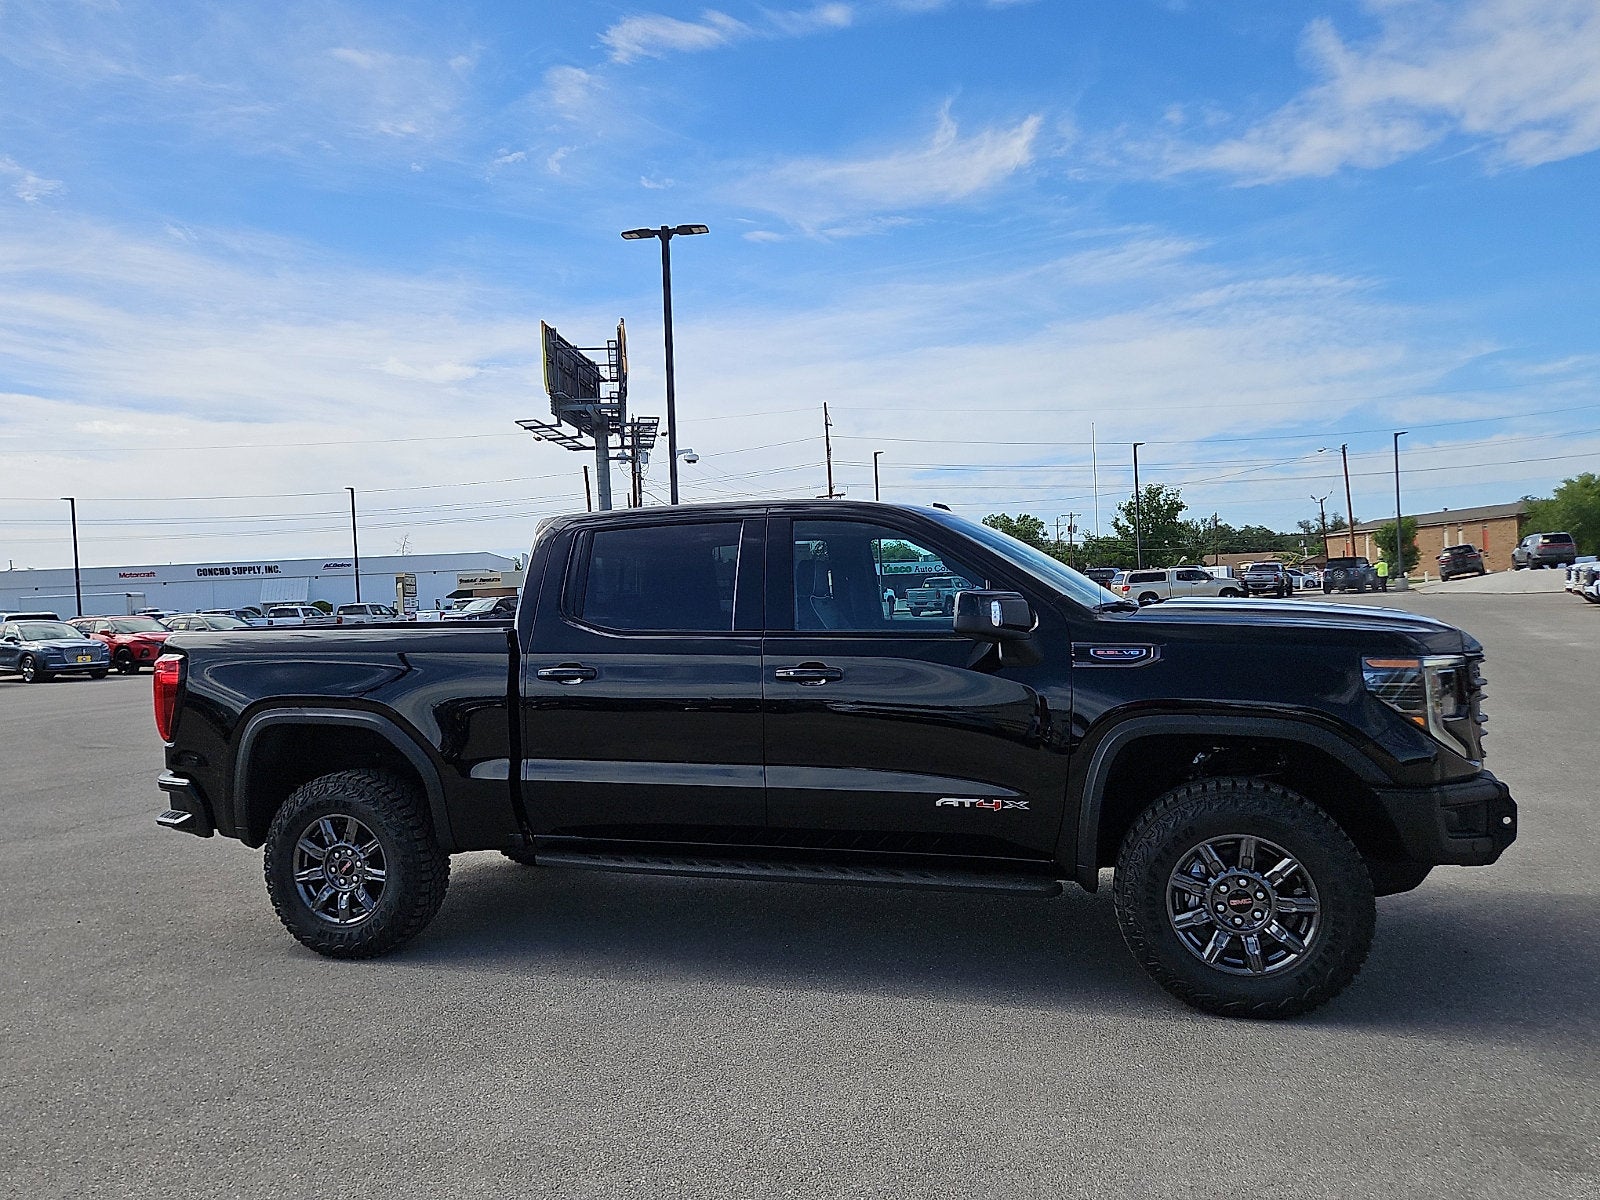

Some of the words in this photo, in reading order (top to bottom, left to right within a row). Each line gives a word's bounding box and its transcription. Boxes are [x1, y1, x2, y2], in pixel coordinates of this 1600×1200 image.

[196, 567, 231, 577] CONCHO
[231, 565, 264, 576] SUPPLY,
[264, 564, 282, 574] INC.
[914, 565, 933, 573] Auto
[934, 564, 949, 573] Co
[118, 571, 156, 579] Motorcraft
[935, 797, 1030, 811] AT4X
[1229, 897, 1253, 906] GMC
